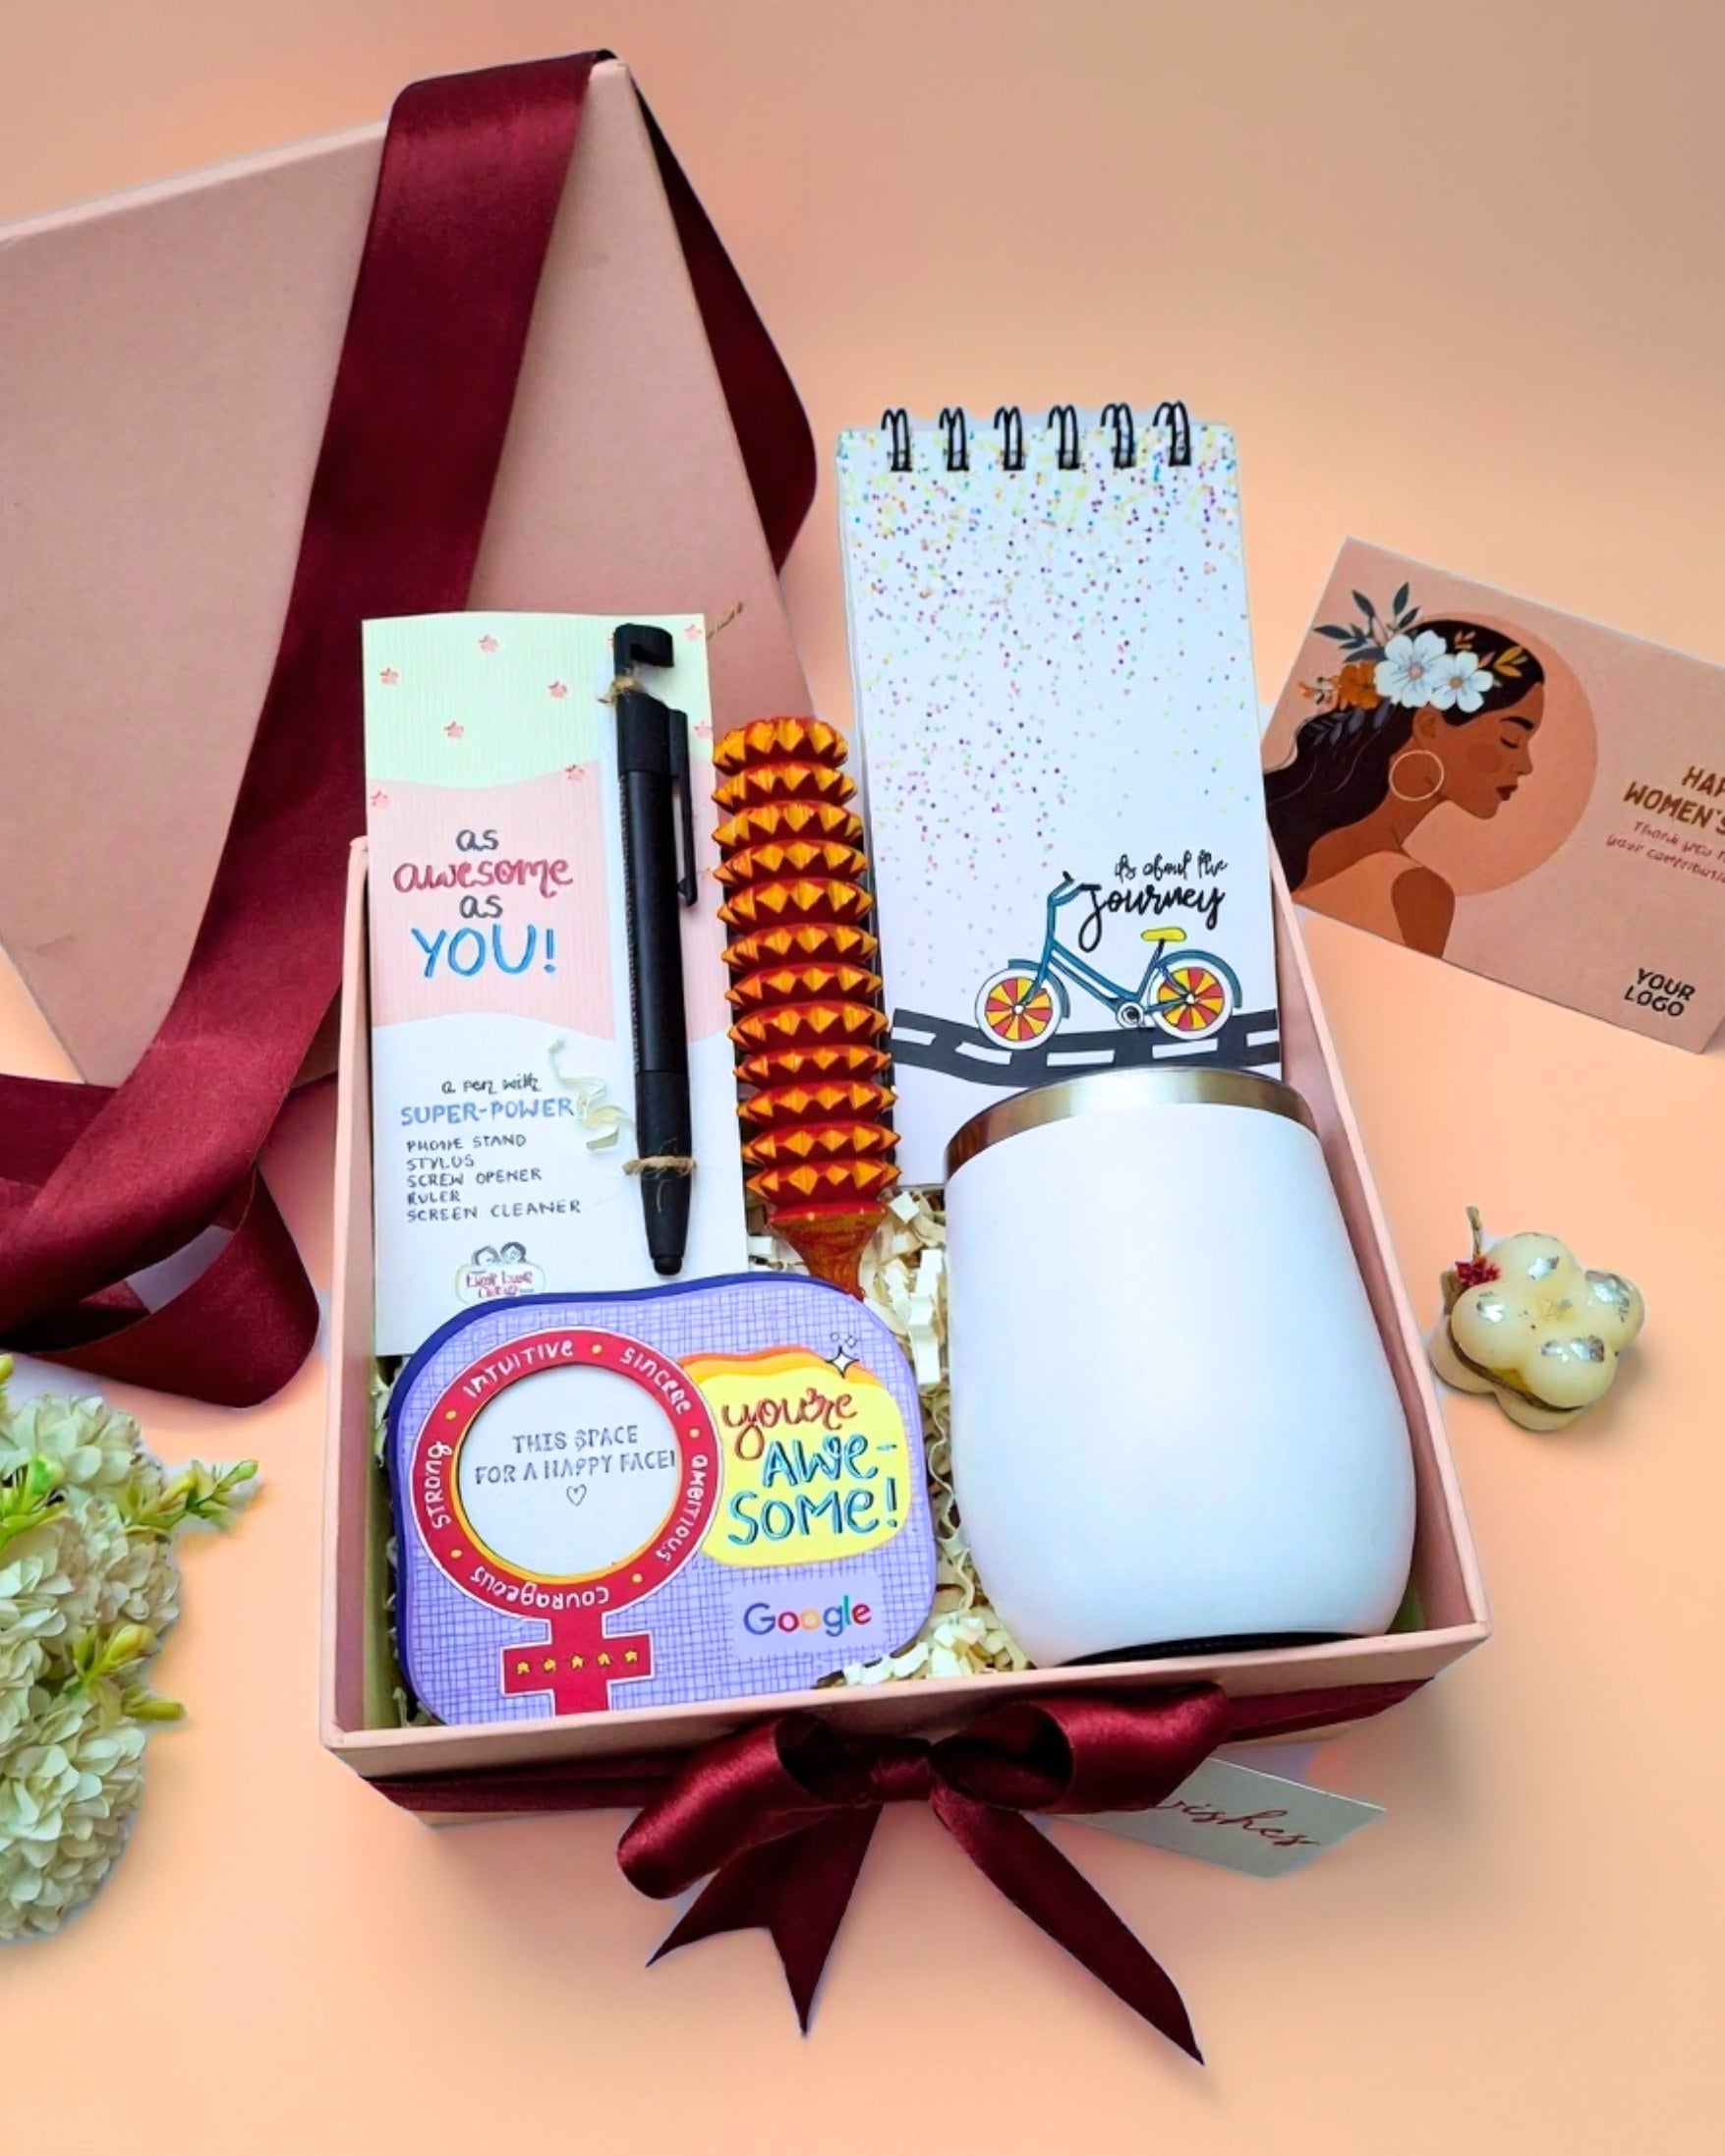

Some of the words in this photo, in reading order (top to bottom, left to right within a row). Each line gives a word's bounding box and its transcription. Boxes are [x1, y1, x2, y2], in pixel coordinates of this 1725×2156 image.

[455, 828, 499, 852] as
[393, 859, 574, 898] awesome
[1197, 849, 1229, 879] the
[459, 894, 503, 919] as
[411, 924, 556, 978] YOU!
[1637, 967, 1696, 1002] YOUR
[1624, 985, 1684, 1018] LOGO
[441, 1080, 456, 1094] a
[463, 1080, 497, 1095] pen
[502, 1072, 542, 1092] with
[406, 1138, 463, 1153] PHONE
[473, 1134, 527, 1149] STAND
[406, 1173, 464, 1188] SCREW
[476, 1167, 543, 1185] OPENER
[407, 1189, 461, 1206] RULER
[407, 1206, 478, 1222] SCREEN
[490, 1199, 581, 1218] CLEANER
[721, 1388, 858, 1461] you're
[512, 1432, 567, 1454] THIS
[574, 1425, 638, 1451] SPACE
[475, 1464, 516, 1485] FOR
[523, 1462, 538, 1481] A
[545, 1454, 612, 1479] HAPPY
[743, 1595, 872, 1638] Google
